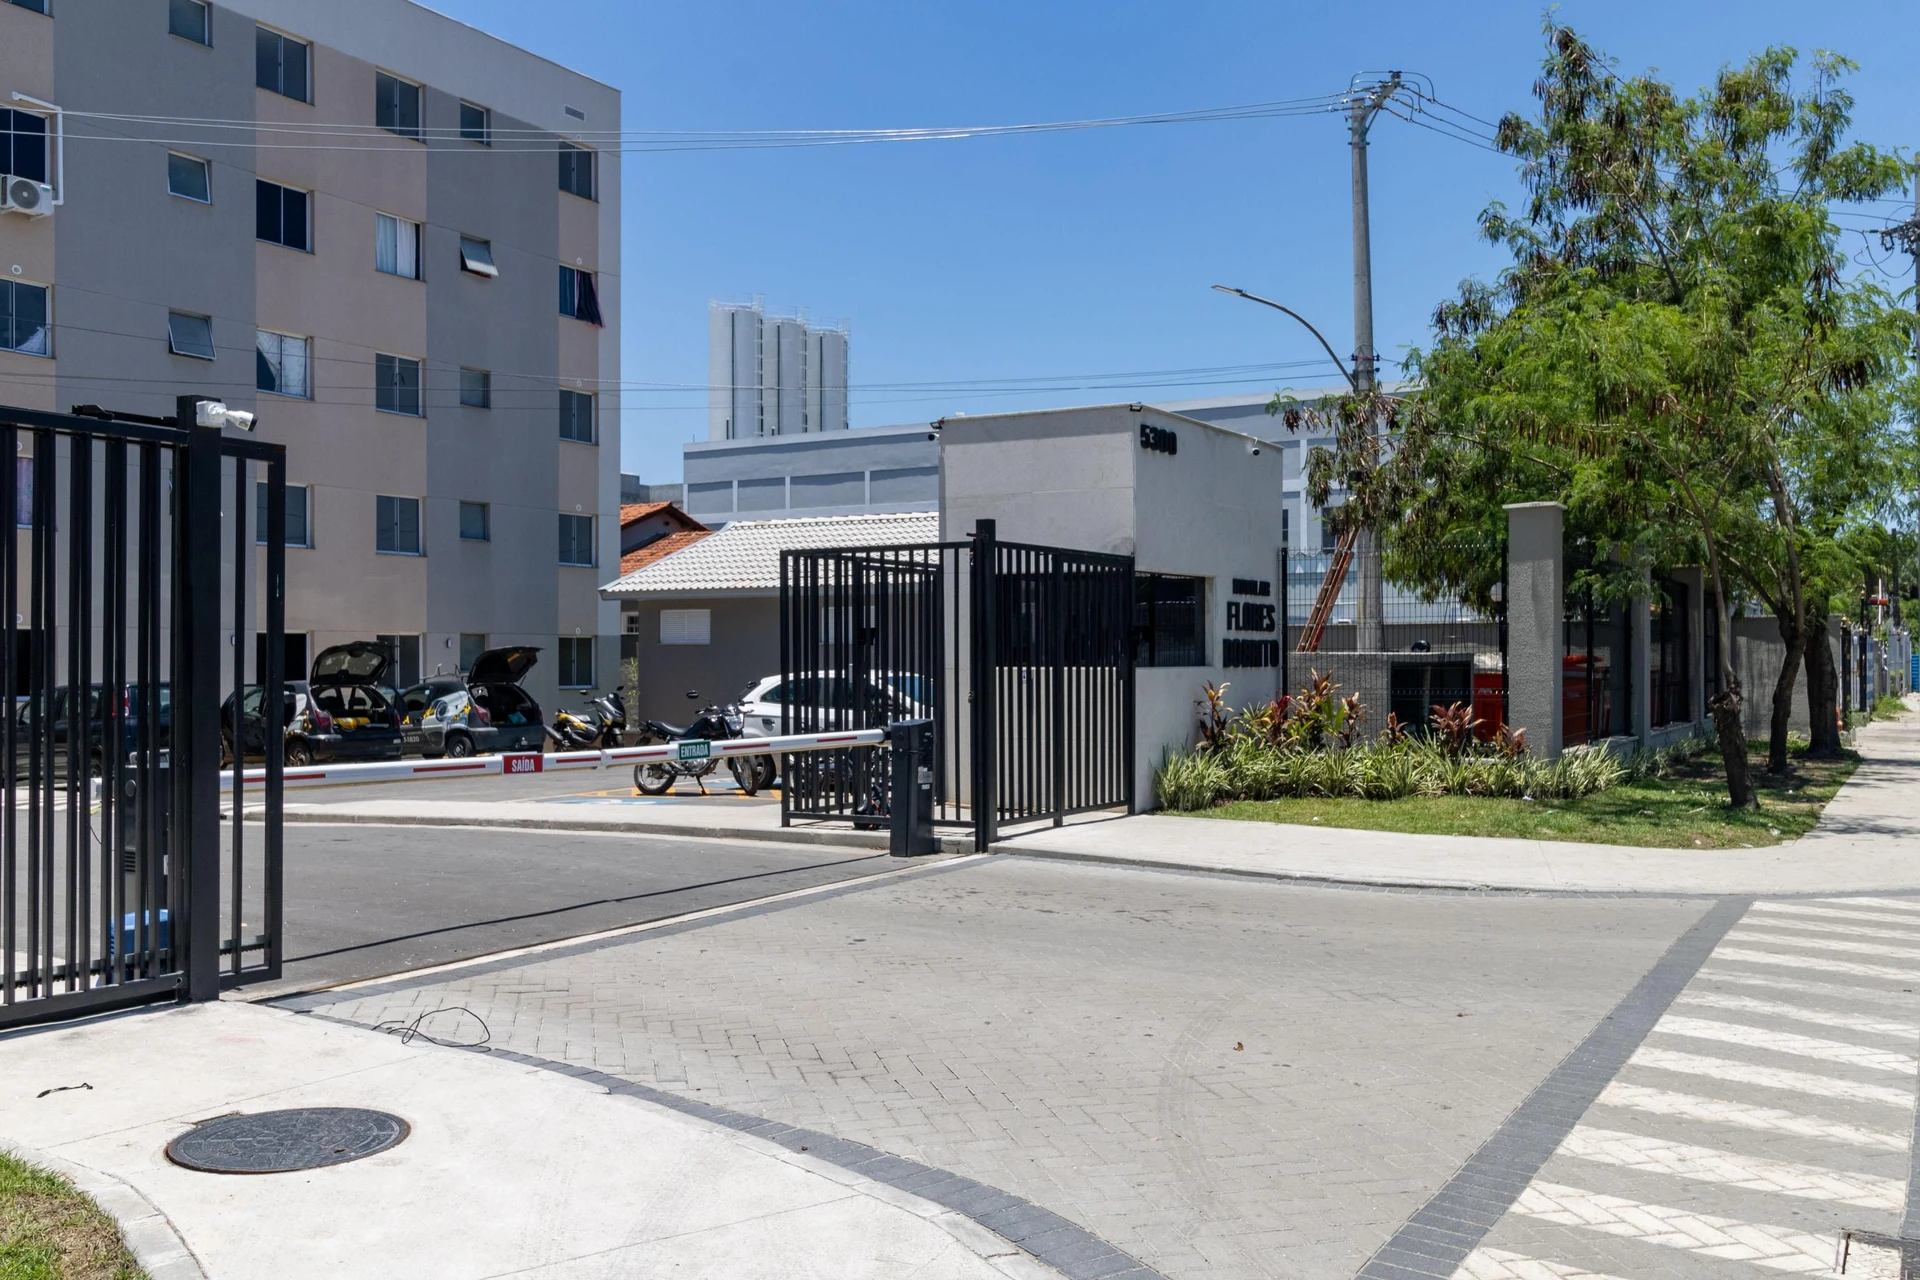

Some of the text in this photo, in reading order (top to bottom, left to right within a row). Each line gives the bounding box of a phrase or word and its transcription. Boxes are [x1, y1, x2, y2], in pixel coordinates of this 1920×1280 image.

[1140, 424, 1177, 455] 5300
[1227, 601, 1275, 632] FLORES
[681, 744, 708, 758] ENTRADA
[511, 756, 535, 773] SAÍDA
